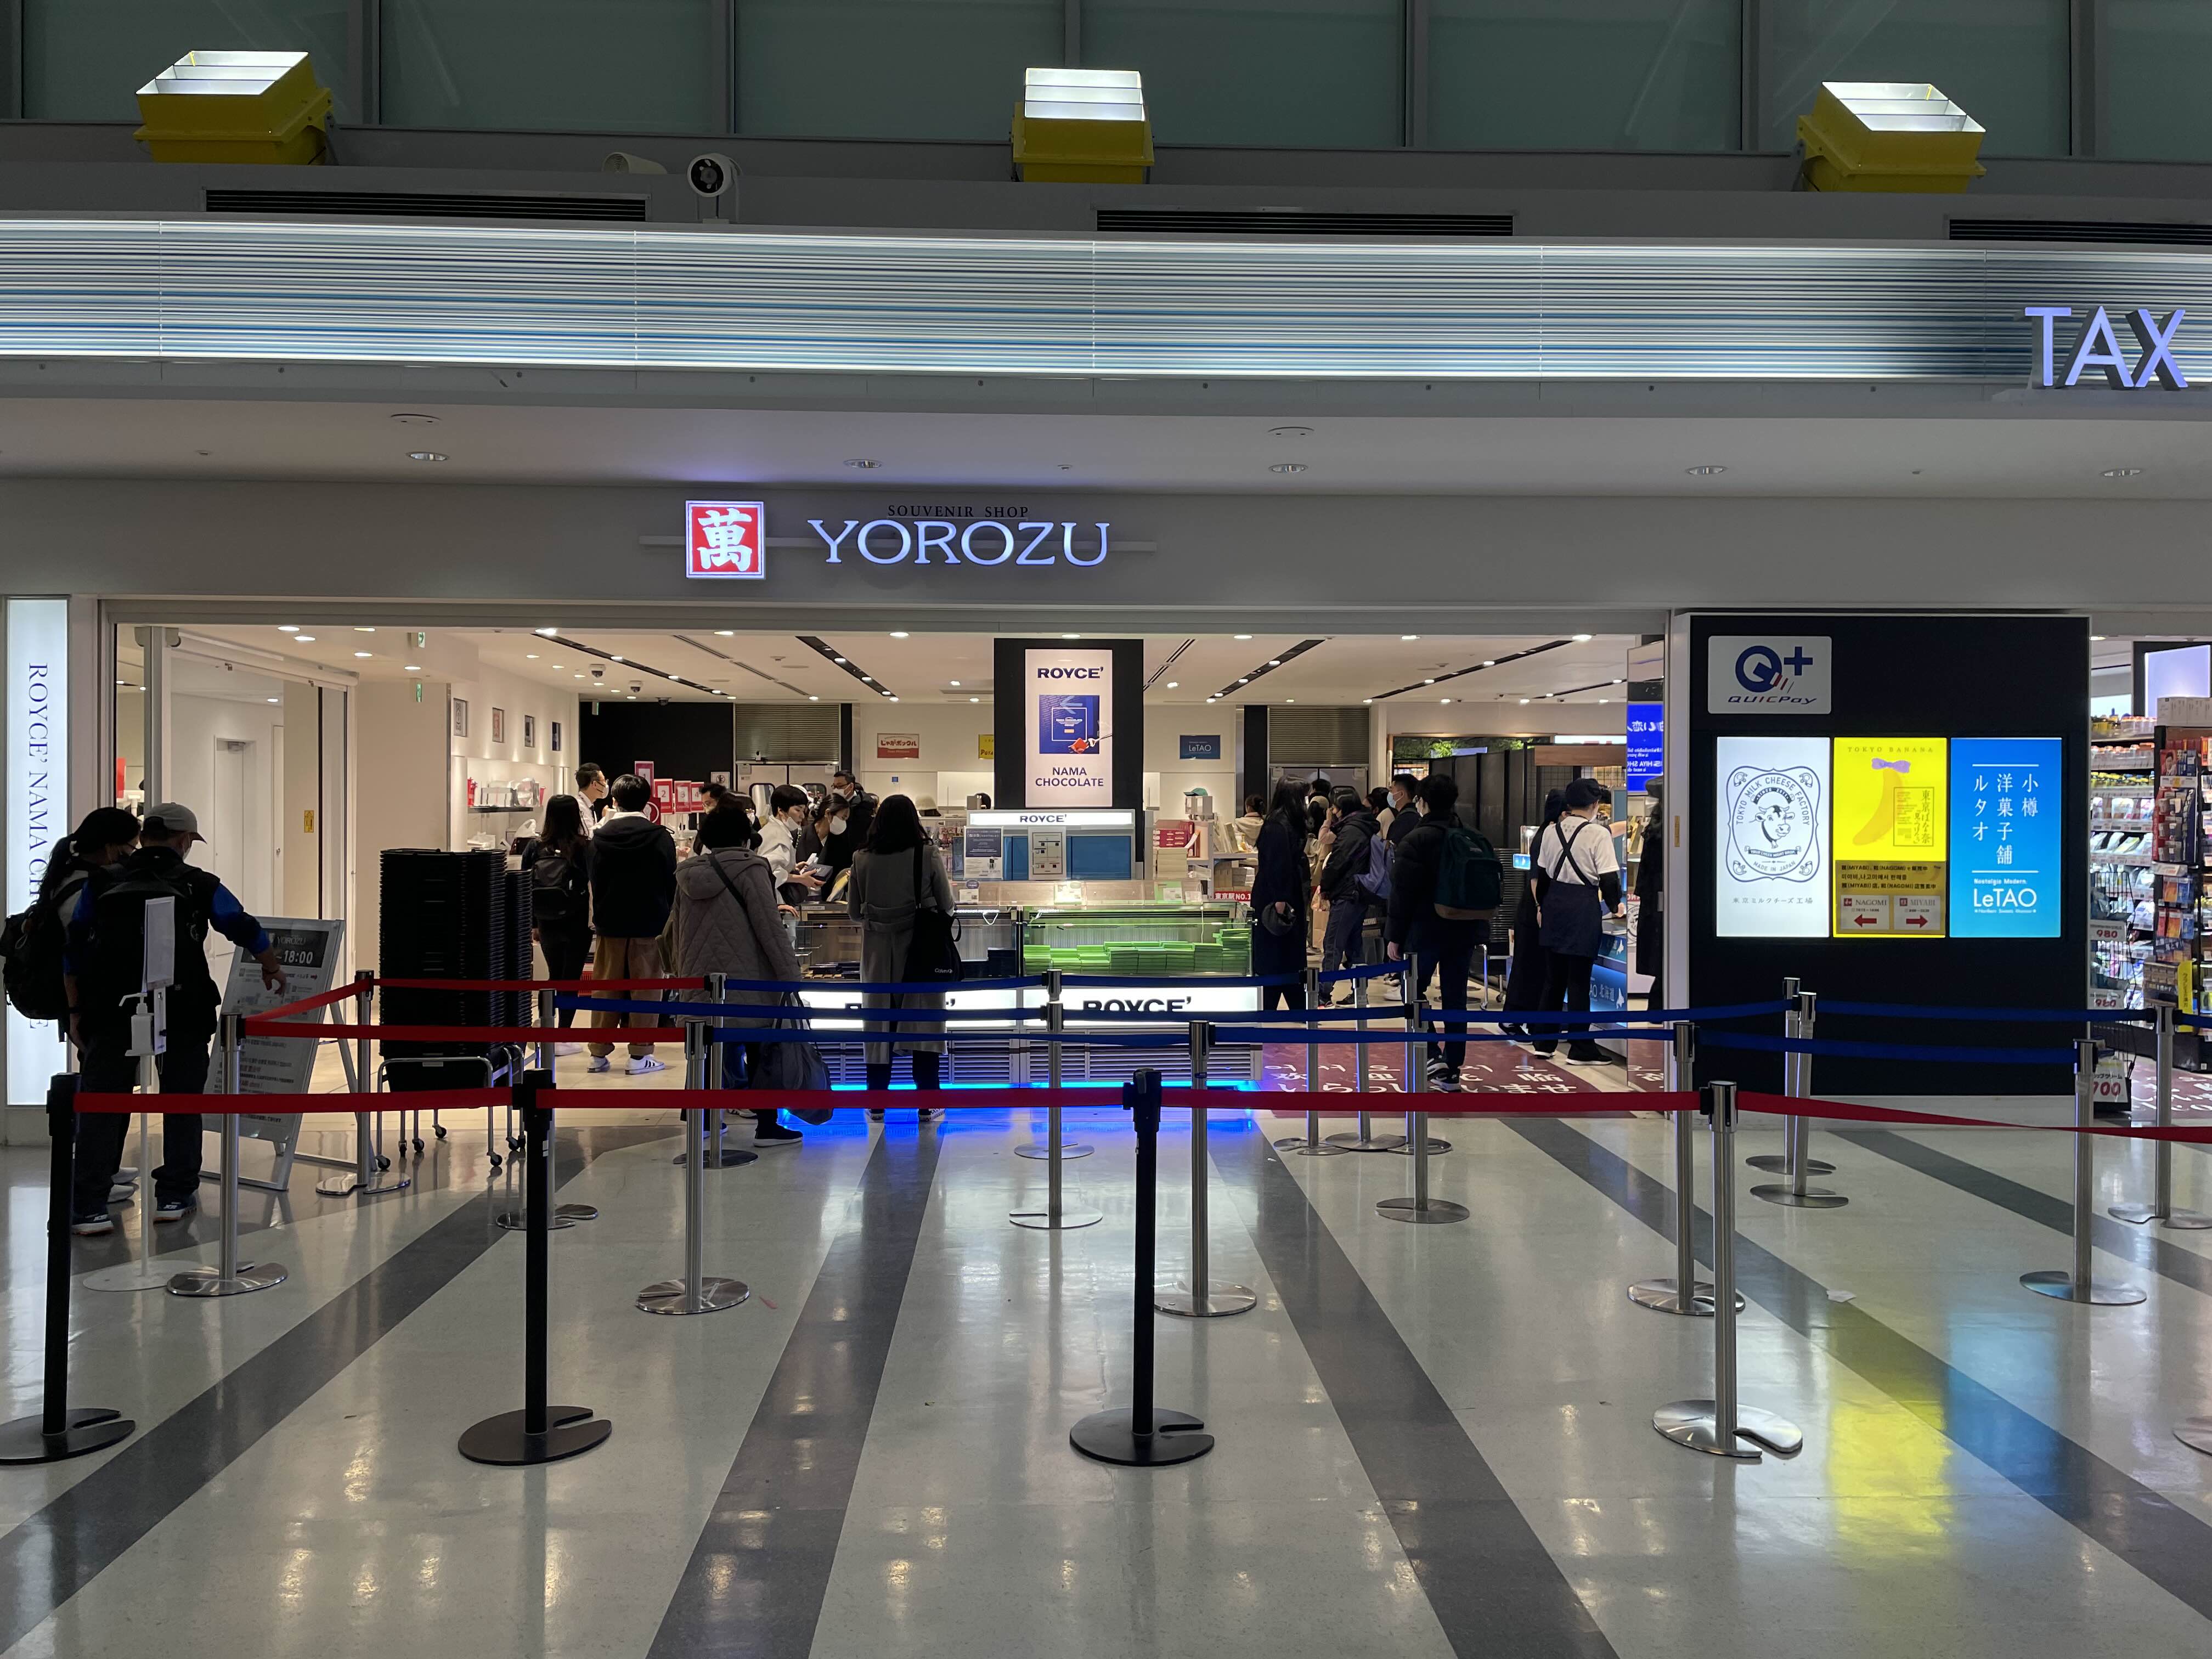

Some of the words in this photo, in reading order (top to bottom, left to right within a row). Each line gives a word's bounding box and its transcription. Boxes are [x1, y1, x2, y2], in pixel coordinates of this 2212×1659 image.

[2025, 306, 2188, 388] TAX
[888, 504, 974, 517] SOUVENIR
[985, 505, 1029, 518] SHOP
[698, 507, 752, 572] 萬
[807, 519, 1110, 567] YOROZU
[1037, 667, 1104, 679] ROYCE'
[1728, 696, 1817, 705] QUICPay
[29, 663, 48, 763] ROYCE'
[1052, 767, 1087, 776] NAMA
[1035, 778, 1104, 787] CHOCOLATE
[1736, 800, 1748, 825] TOKYO
[1745, 776, 1763, 797] MILK
[1765, 776, 1796, 791] CHEESE
[1795, 791, 1810, 826] FACTORY
[2022, 773, 2039, 817] 小樽
[29, 771, 48, 851] NAMA
[1972, 775, 1989, 842] ルタオ
[1020, 814, 1067, 823] ROYCE'
[1997, 772, 2013, 865] 洋菓子舗
[1753, 861, 1768, 871] MADE
[1780, 861, 1796, 871] JAPAN
[1973, 888, 2037, 907] LeTAO
[277, 936, 306, 945] YOROZU
[2096, 929, 2118, 938] 980
